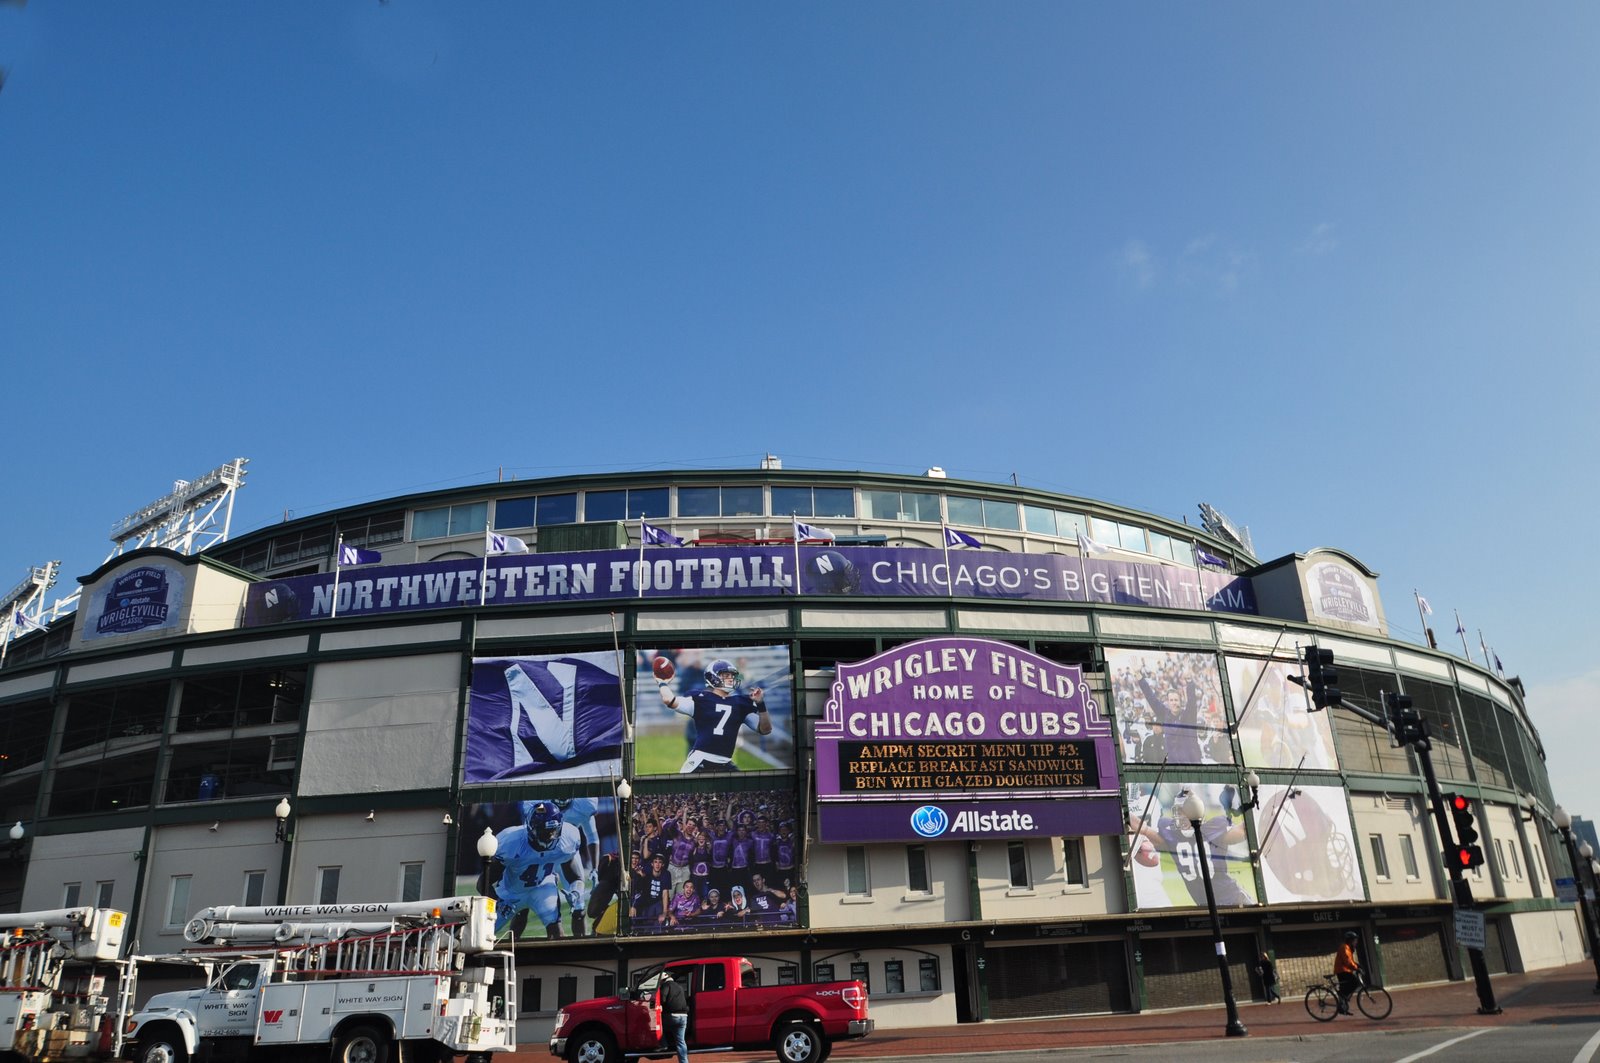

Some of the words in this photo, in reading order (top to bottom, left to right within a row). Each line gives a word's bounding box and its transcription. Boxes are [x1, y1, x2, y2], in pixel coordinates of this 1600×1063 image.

[344, 548, 358, 565] N
[815, 554, 834, 575] N
[118, 570, 145, 586] WRIGLEY
[145, 570, 161, 579] FIELD
[310, 562, 597, 615] NORTHWESTERN
[610, 556, 792, 592] FOOTBALL
[871, 561, 1051, 590] CHICAGO'S
[1062, 569, 1109, 594] BG
[1118, 575, 1172, 600] TEN
[264, 588, 279, 608] N
[1321, 597, 1368, 617] WRIGLEYVILLE
[100, 604, 167, 628] WRIGLEYVILLE
[847, 647, 977, 700] WRIGLEY
[991, 650, 1075, 699] FIELD
[913, 685, 974, 700] HOME
[989, 685, 1016, 700] OF
[504, 662, 577, 768] N
[713, 703, 733, 735] 7
[848, 711, 986, 737] CHICAGO
[1000, 711, 1081, 736] CUBS
[860, 745, 914, 758] AMPM
[918, 744, 977, 757] SECRET
[981, 744, 1027, 757] MENU
[1030, 744, 1054, 757] TIP
[849, 761, 916, 773] REPLACE
[919, 760, 1006, 773] BREAKFAST
[1009, 759, 1085, 771] SANDWICH
[856, 776, 886, 789] BUN
[890, 775, 932, 788] WITH
[935, 774, 993, 787] GLAZED
[995, 773, 1084, 787] DOUGHNUTS!
[951, 810, 1034, 833] Allstate
[264, 906, 312, 917] WHITE
[316, 904, 348, 915] WAY
[351, 904, 389, 914] SIGN
[1313, 911, 1333, 922] GATE
[961, 930, 971, 941] G
